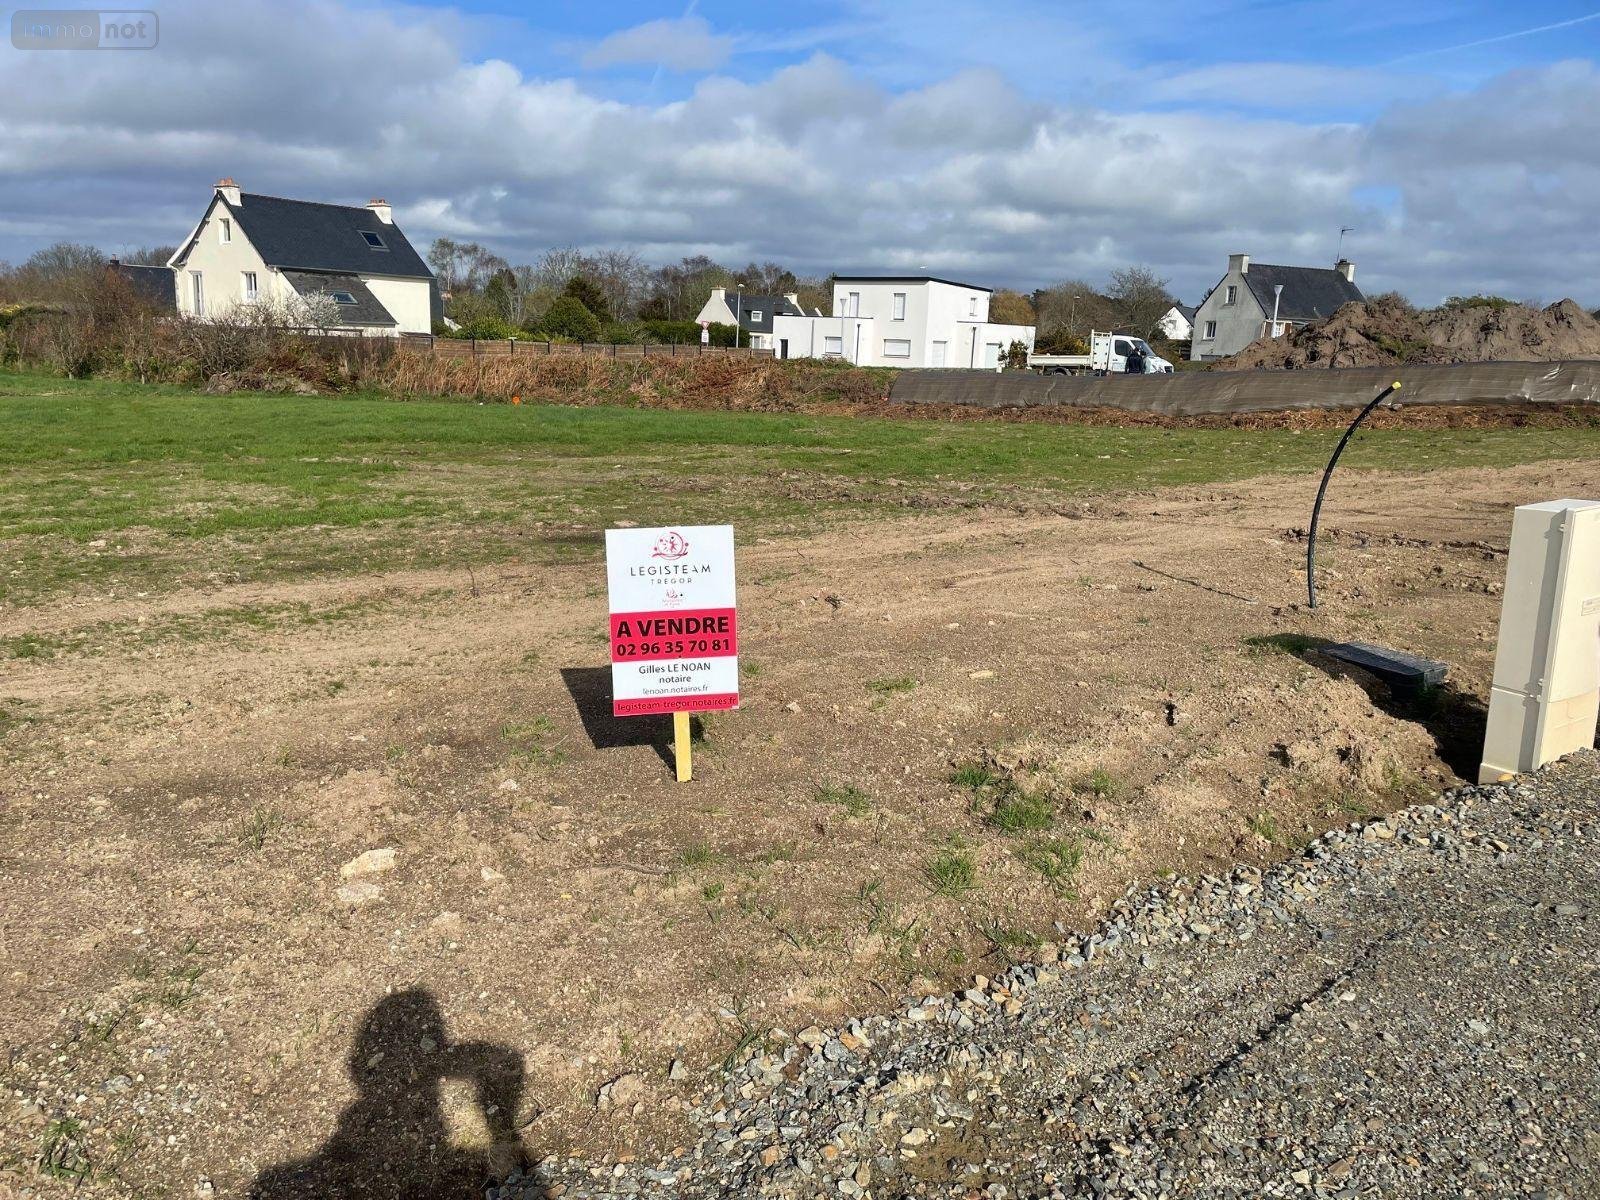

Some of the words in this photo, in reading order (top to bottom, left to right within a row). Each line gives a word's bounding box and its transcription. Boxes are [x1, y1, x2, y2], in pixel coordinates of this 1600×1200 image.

[630, 564, 711, 577] LEGISTEAM
[617, 621, 632, 638] A
[637, 617, 729, 637] VENDRE
[617, 644, 636, 656] 02
[641, 642, 660, 655] 96
[665, 641, 684, 654] 35
[688, 640, 708, 652] 70
[712, 639, 729, 651] 81
[638, 665, 665, 675] Gilles
[667, 663, 679, 673] LE
[681, 662, 711, 672] NOAN
[659, 675, 692, 684] notaire
